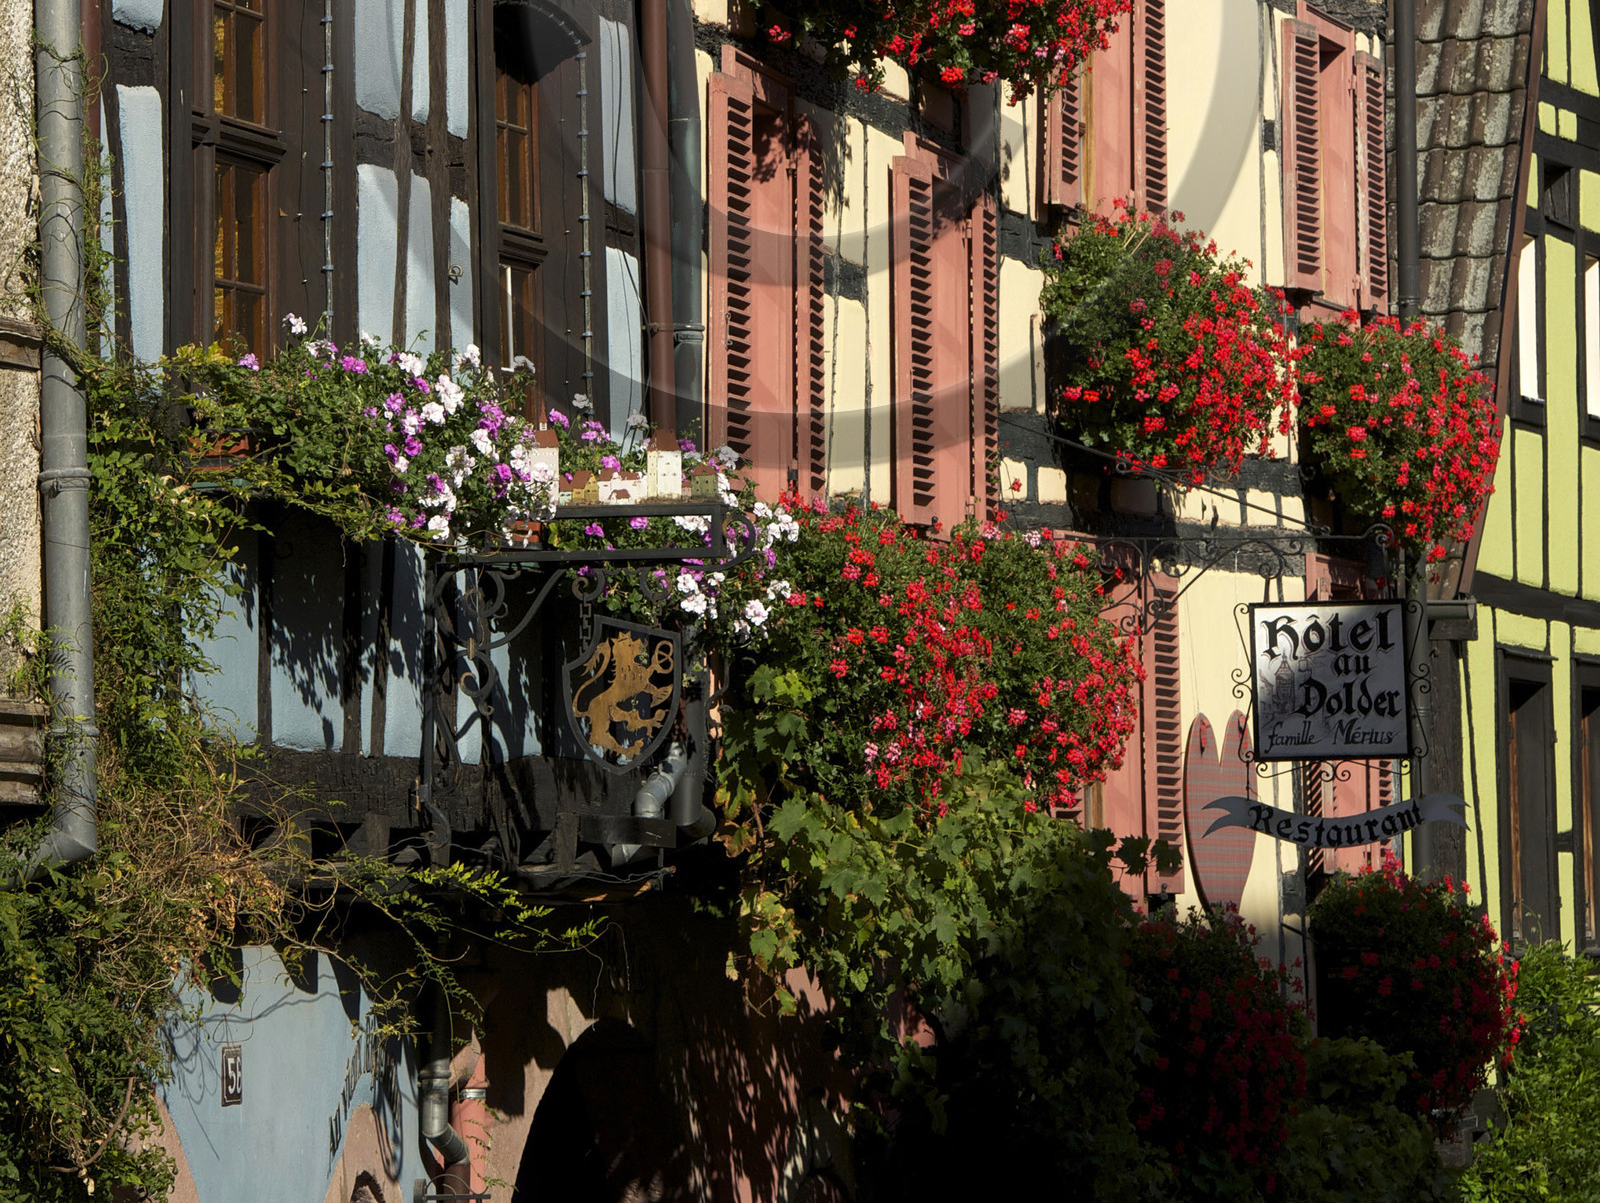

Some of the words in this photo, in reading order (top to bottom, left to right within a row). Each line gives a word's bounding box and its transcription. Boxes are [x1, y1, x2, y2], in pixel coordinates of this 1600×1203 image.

[1261, 609, 1395, 660] Hôtel
[1333, 652, 1373, 677] au
[1294, 676, 1403, 719] Dolder
[1263, 720, 1319, 754] famille
[1248, 799, 1425, 848] Restaurant
